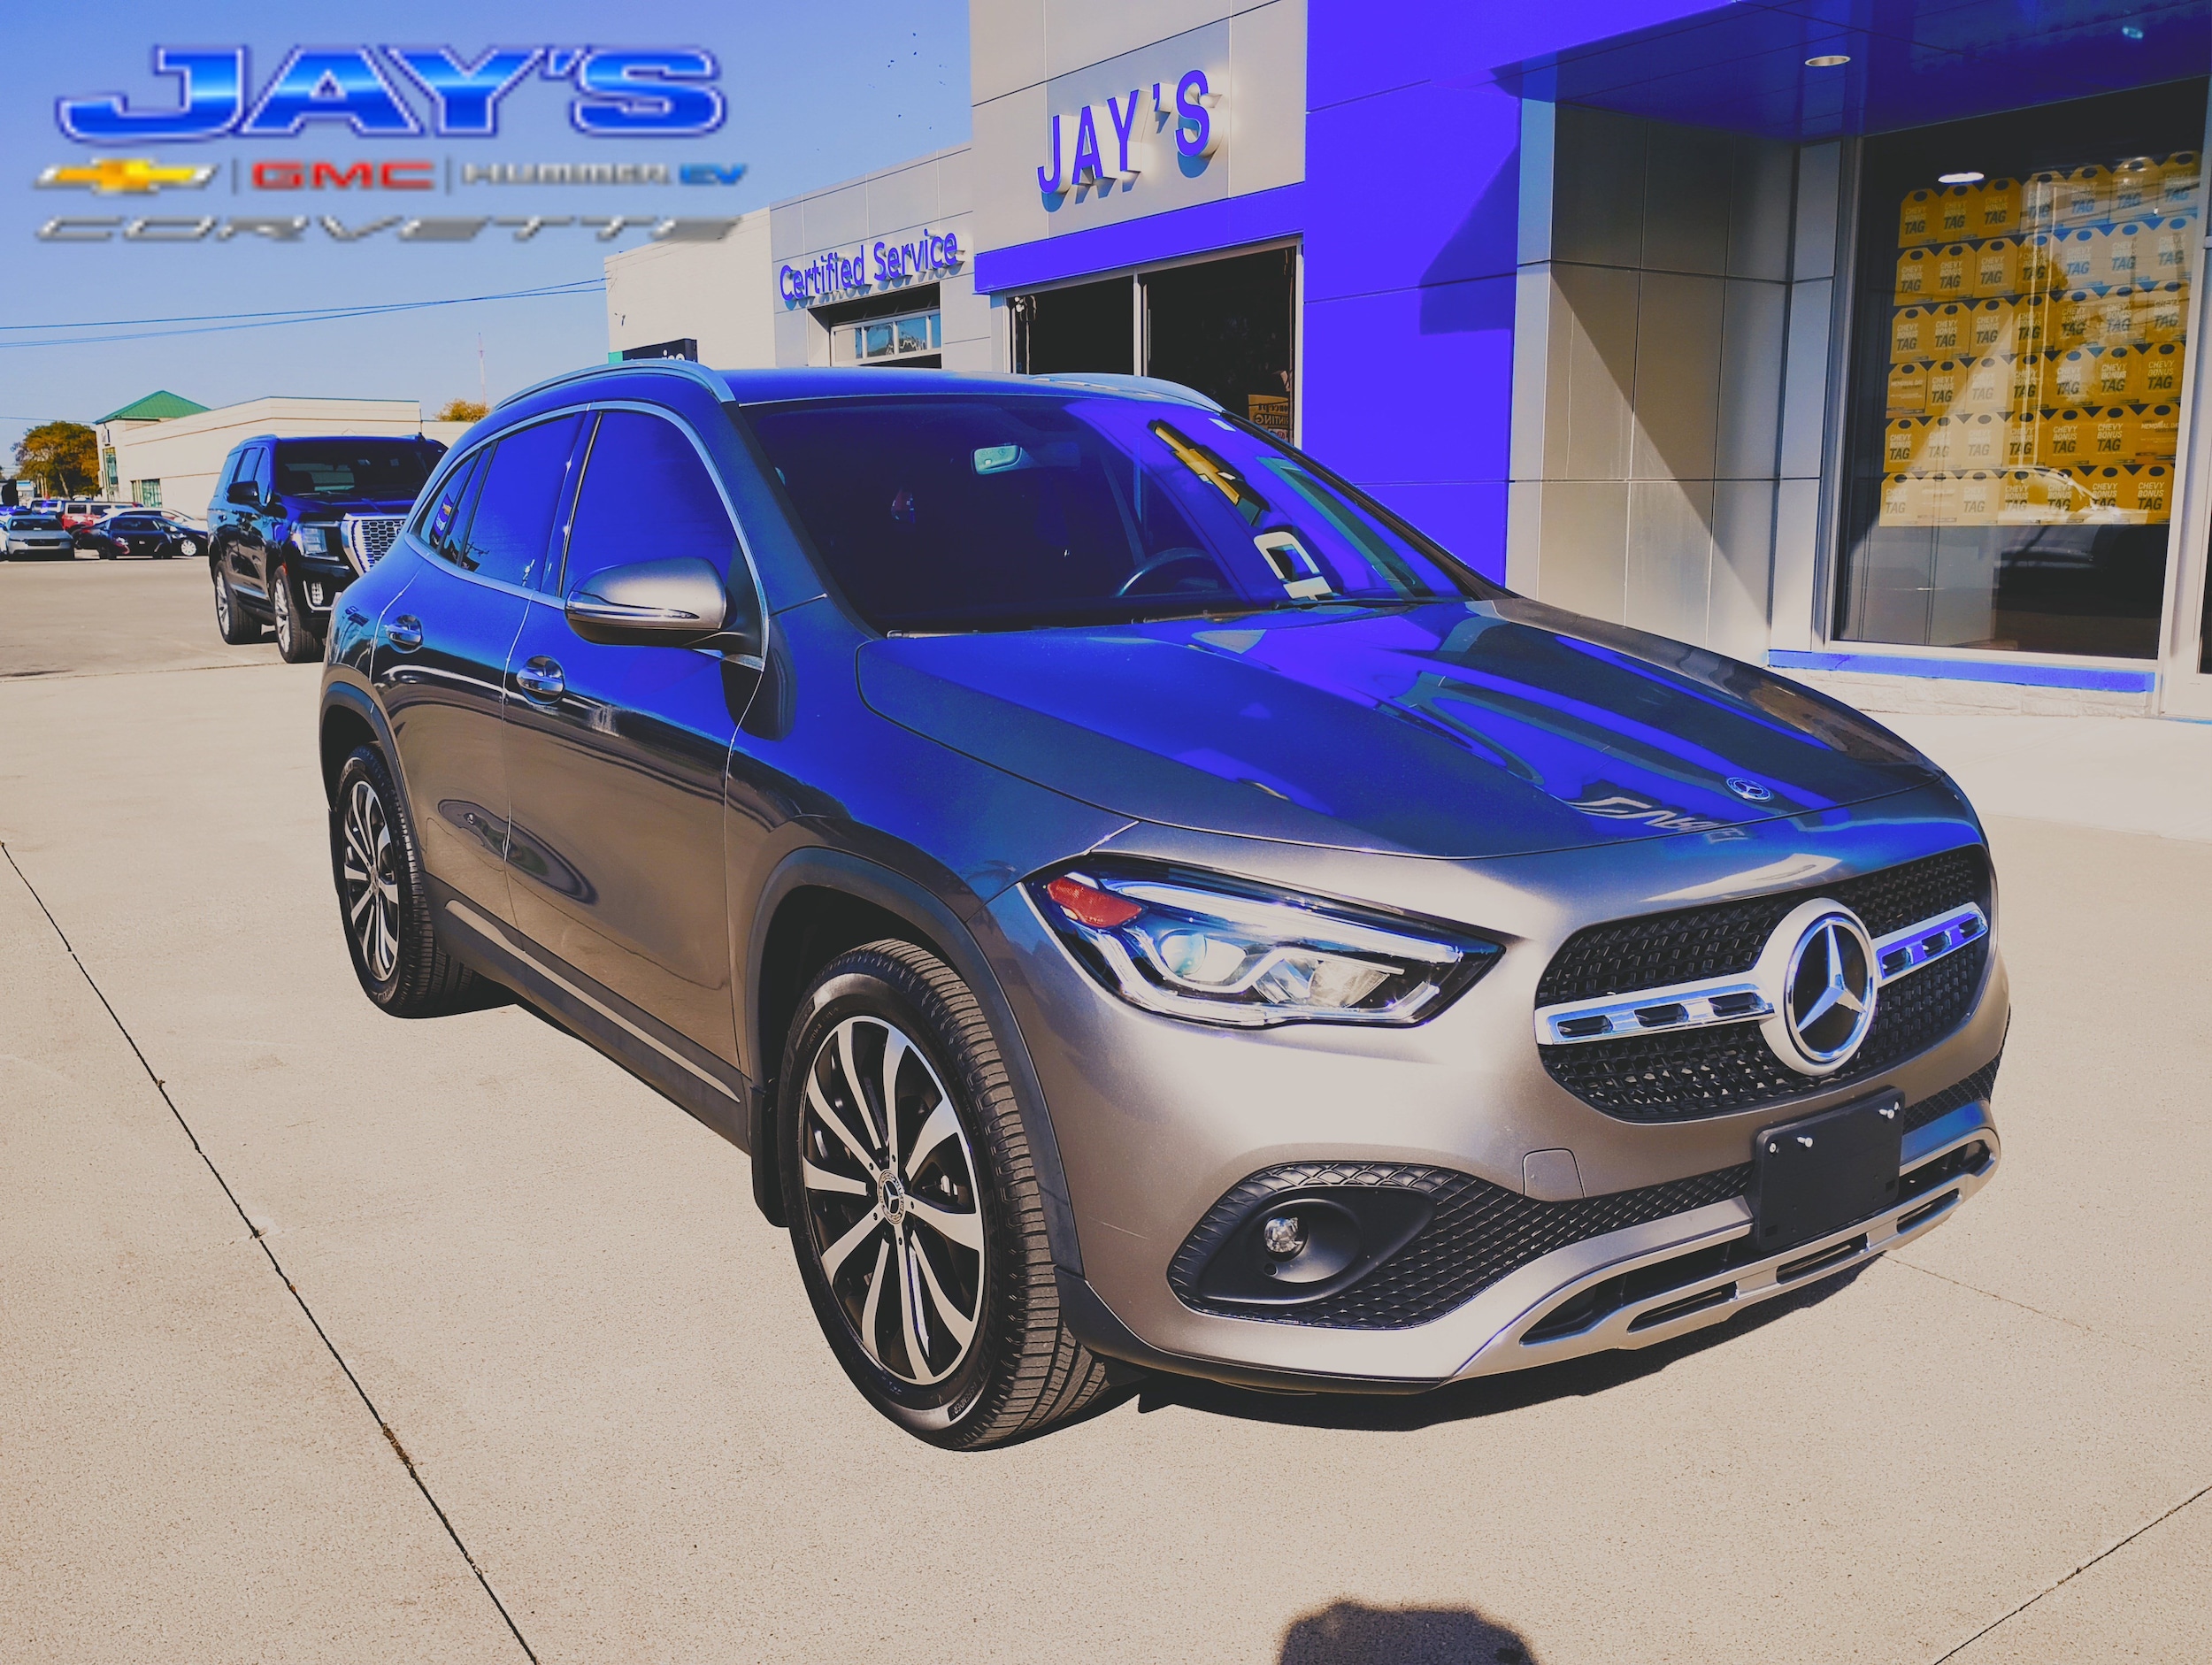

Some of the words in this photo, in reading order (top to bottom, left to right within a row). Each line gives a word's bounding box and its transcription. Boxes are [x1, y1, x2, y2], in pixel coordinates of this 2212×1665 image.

[1037, 69, 1210, 194] JAY'S
[1945, 201, 1968, 210] CHEVY
[1985, 195, 2008, 204] CHEVY
[1906, 206, 1927, 215] CHEVY
[1985, 203, 2008, 211] BONUS
[1944, 216, 1965, 229] TAG
[1985, 211, 2007, 225] TAG
[1905, 221, 1925, 234] TAG
[780, 244, 865, 302] Certified
[874, 228, 958, 281] Service
[1941, 261, 1962, 270] CHEVY
[1982, 256, 2004, 265] CHEVY
[1939, 276, 1961, 288] TAG
[1980, 271, 2002, 285] TAG
[1901, 280, 1921, 293] TAG
[1977, 315, 2000, 324] CHEVY
[2107, 318, 2131, 333] TAG
[1897, 323, 1918, 332] CHEVY
[2062, 322, 2085, 336] TAG
[1934, 334, 1956, 347] TAG
[1976, 330, 1998, 343] TAG
[1897, 338, 1917, 350] TAG
[2102, 363, 2127, 372] CHEVY
[2057, 374, 2080, 383] BONUS
[2101, 371, 2126, 380] BONUS
[2056, 382, 2079, 395] TAG
[2101, 379, 2125, 392] TAG
[2147, 376, 2173, 389] TAG
[1932, 390, 1953, 403] TAG
[2009, 442, 2032, 456] TAG
[2053, 441, 2076, 453] TAG
[2097, 439, 2121, 451] TAG
[1890, 448, 1910, 460] TAG
[2005, 500, 2027, 511] TAG
[2047, 499, 2070, 511] TAG
[2092, 498, 2116, 510] TAG
[2138, 498, 2162, 510] TAG
